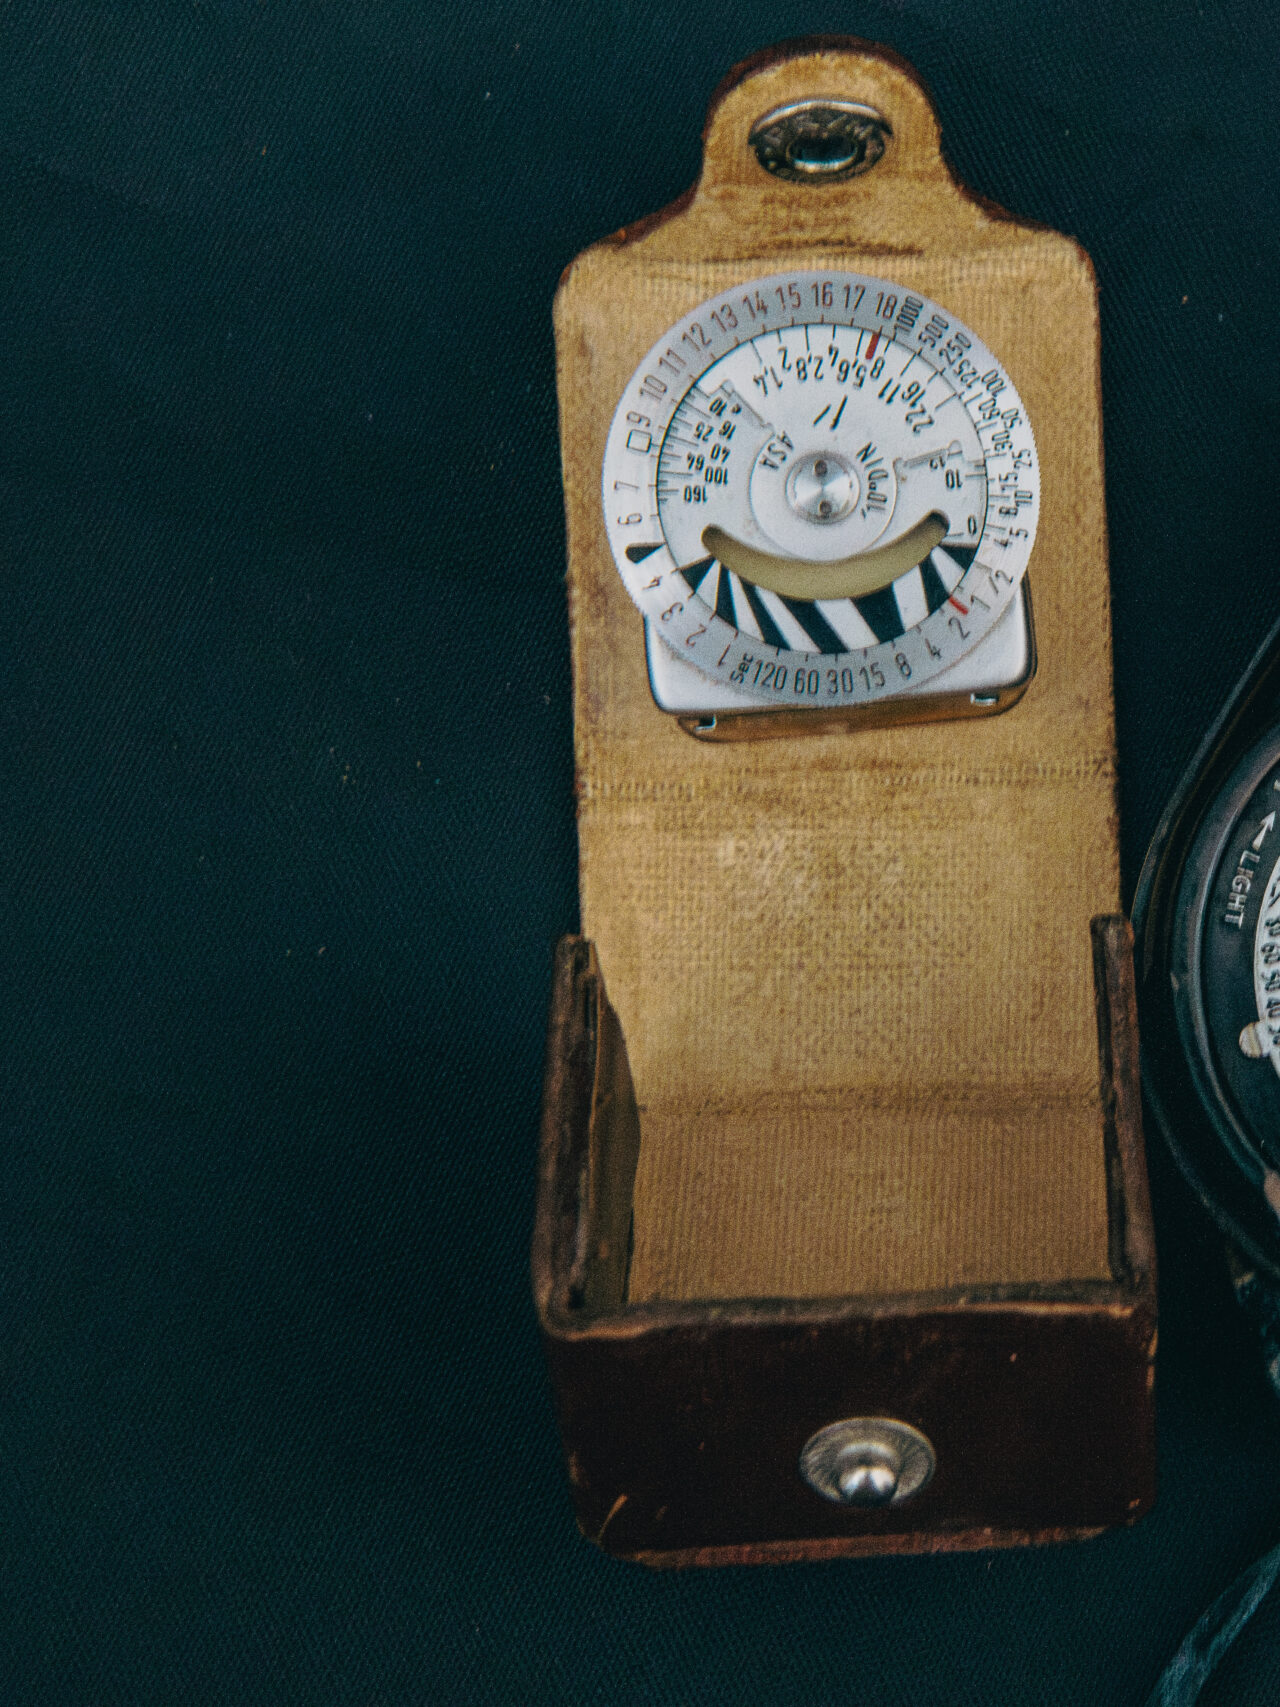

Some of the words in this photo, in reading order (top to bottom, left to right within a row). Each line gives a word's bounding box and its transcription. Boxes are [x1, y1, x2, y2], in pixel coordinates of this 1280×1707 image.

[893, 295, 924, 336] 1000
[640, 374, 667, 401] 10
[659, 347, 687, 375] 11
[682, 322, 711, 351] 12
[710, 303, 738, 333] 13
[742, 290, 768, 319] 14
[775, 282, 801, 311] 15
[811, 281, 833, 308] 16
[843, 284, 865, 312] 17
[876, 291, 898, 319] 18
[918, 314, 949, 348] 500
[778, 346, 792, 371] 2
[828, 344, 839, 367] 4
[938, 331, 972, 366] 250
[869, 356, 885, 380] 8
[953, 358, 981, 390] 125
[878, 377, 901, 404] 11
[901, 381, 926, 408] 16
[981, 368, 1008, 398] 100
[905, 403, 935, 434] 22
[1001, 407, 1023, 428] 50
[694, 421, 714, 442] 25
[991, 430, 1014, 452] 30
[687, 452, 704, 471] 64
[710, 443, 730, 463] 40
[760, 430, 794, 470] ASA
[1012, 449, 1033, 468] 25
[704, 466, 728, 485] 100
[945, 469, 962, 489] 10
[998, 471, 1019, 491] 15
[683, 485, 708, 503] 160
[661, 602, 683, 621] 3
[685, 624, 707, 648] 2
[753, 660, 788, 690] 120
[794, 667, 820, 696] 60
[827, 668, 853, 696] 30
[859, 662, 886, 692] 15
[895, 652, 912, 680] 8
[925, 638, 941, 660] 4
[949, 617, 970, 640] 2
[1224, 850, 1261, 930] LIGHT
